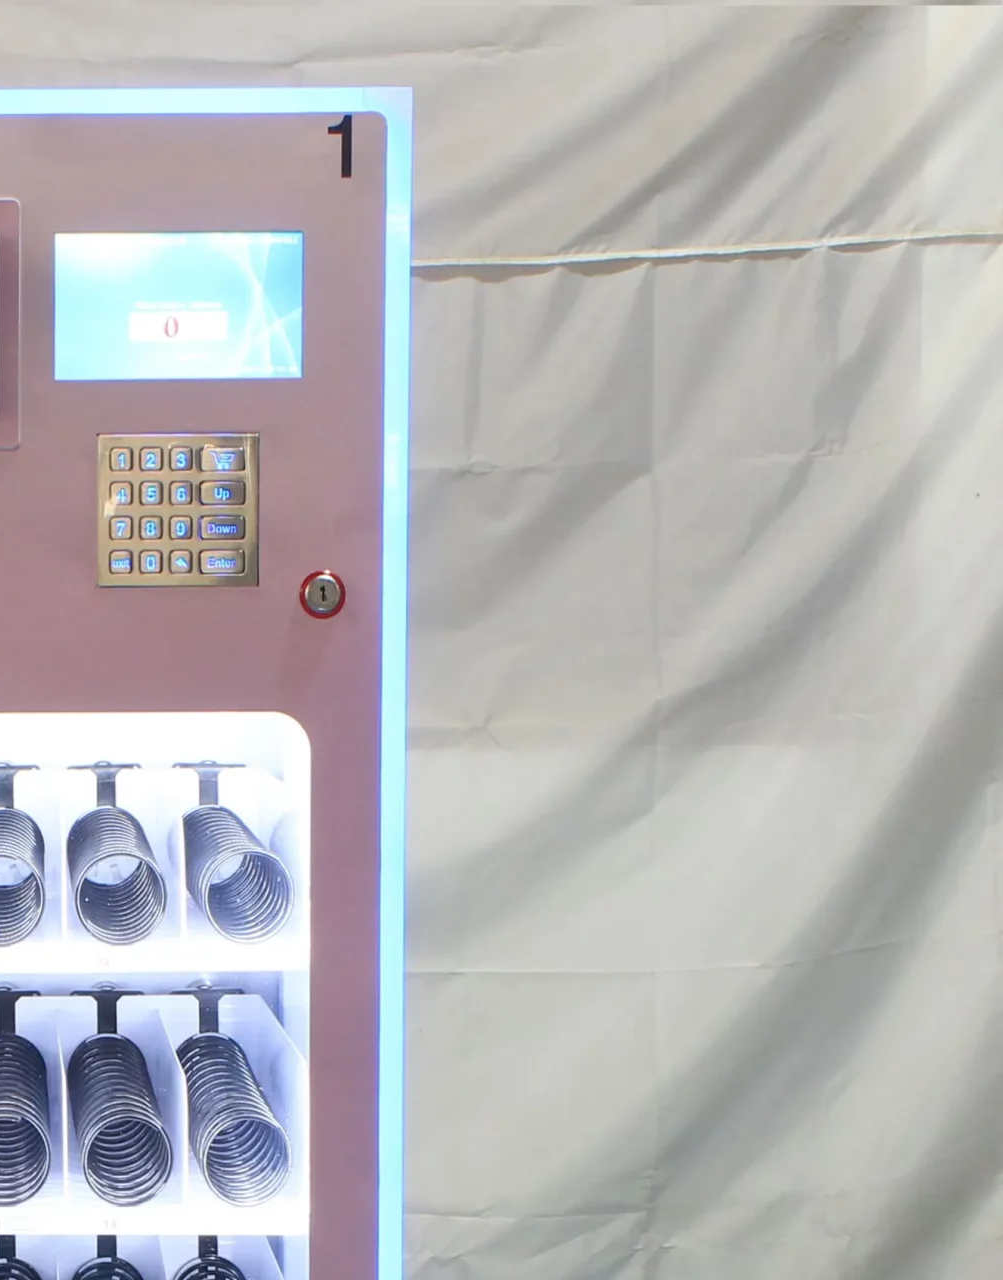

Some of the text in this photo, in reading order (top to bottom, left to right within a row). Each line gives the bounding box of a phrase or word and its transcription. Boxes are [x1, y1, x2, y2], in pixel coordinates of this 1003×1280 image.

[327, 114, 353, 178] 1
[163, 316, 179, 338] 0
[117, 453, 187, 468] 1 2 3
[116, 487, 231, 503] 4 5 6 Up
[115, 522, 237, 537] 7 8 9 Down
[145, 555, 156, 570] 0
[206, 556, 237, 570] Enter
